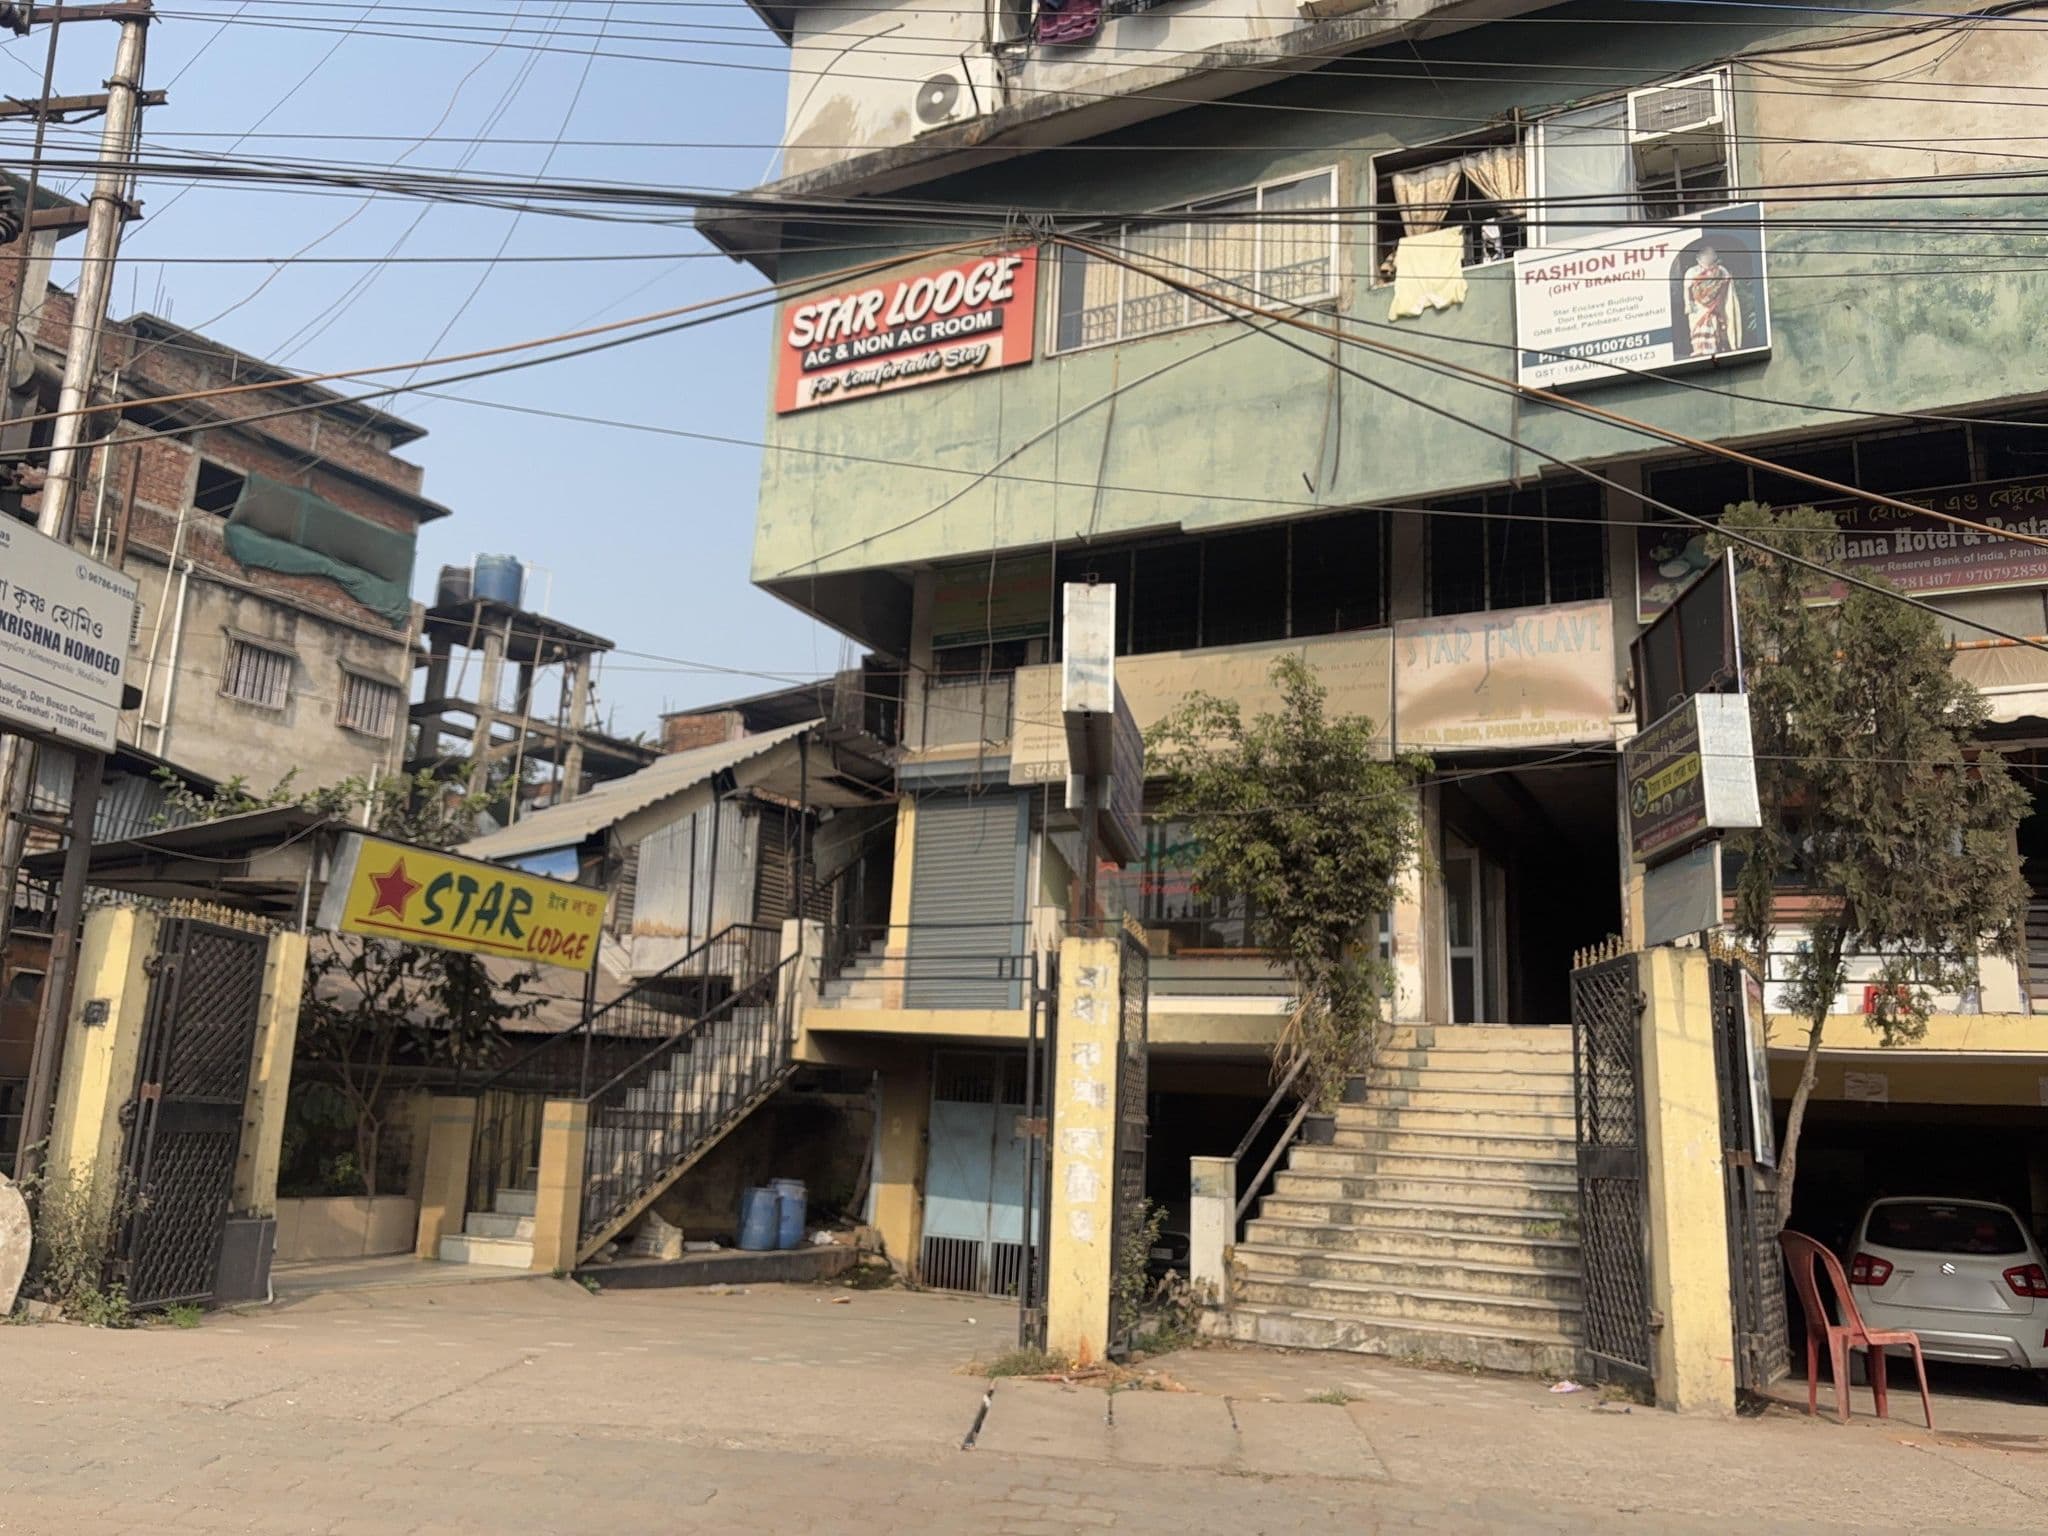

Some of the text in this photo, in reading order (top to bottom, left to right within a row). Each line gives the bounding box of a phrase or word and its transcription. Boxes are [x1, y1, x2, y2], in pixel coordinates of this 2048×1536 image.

[1524, 243, 1670, 285] FASHION HUT
[1548, 267, 1646, 298] (GHY BRANCH)
[788, 254, 1023, 349] STAR LODGE
[804, 310, 993, 368] AC & NON AC ROOM
[1569, 333, 1651, 357] 9101007651
[810, 343, 989, 399] For Comfortable Stay
[1824, 530, 1889, 562] dana
[1894, 522, 1958, 554] Hotel
[1887, 559, 1931, 571] Reserve
[1933, 553, 1961, 566] Bank
[1963, 553, 1976, 565] of
[1977, 549, 2007, 563] India,
[2009, 548, 2032, 560] Pan
[0, 608, 120, 676] KRISHNA HOMOEO
[1406, 629, 1473, 668] STAR
[30, 690, 45, 704] Don
[1024, 762, 1060, 778] STAR
[420, 871, 534, 940] STAR
[525, 924, 590, 960] LODGE
